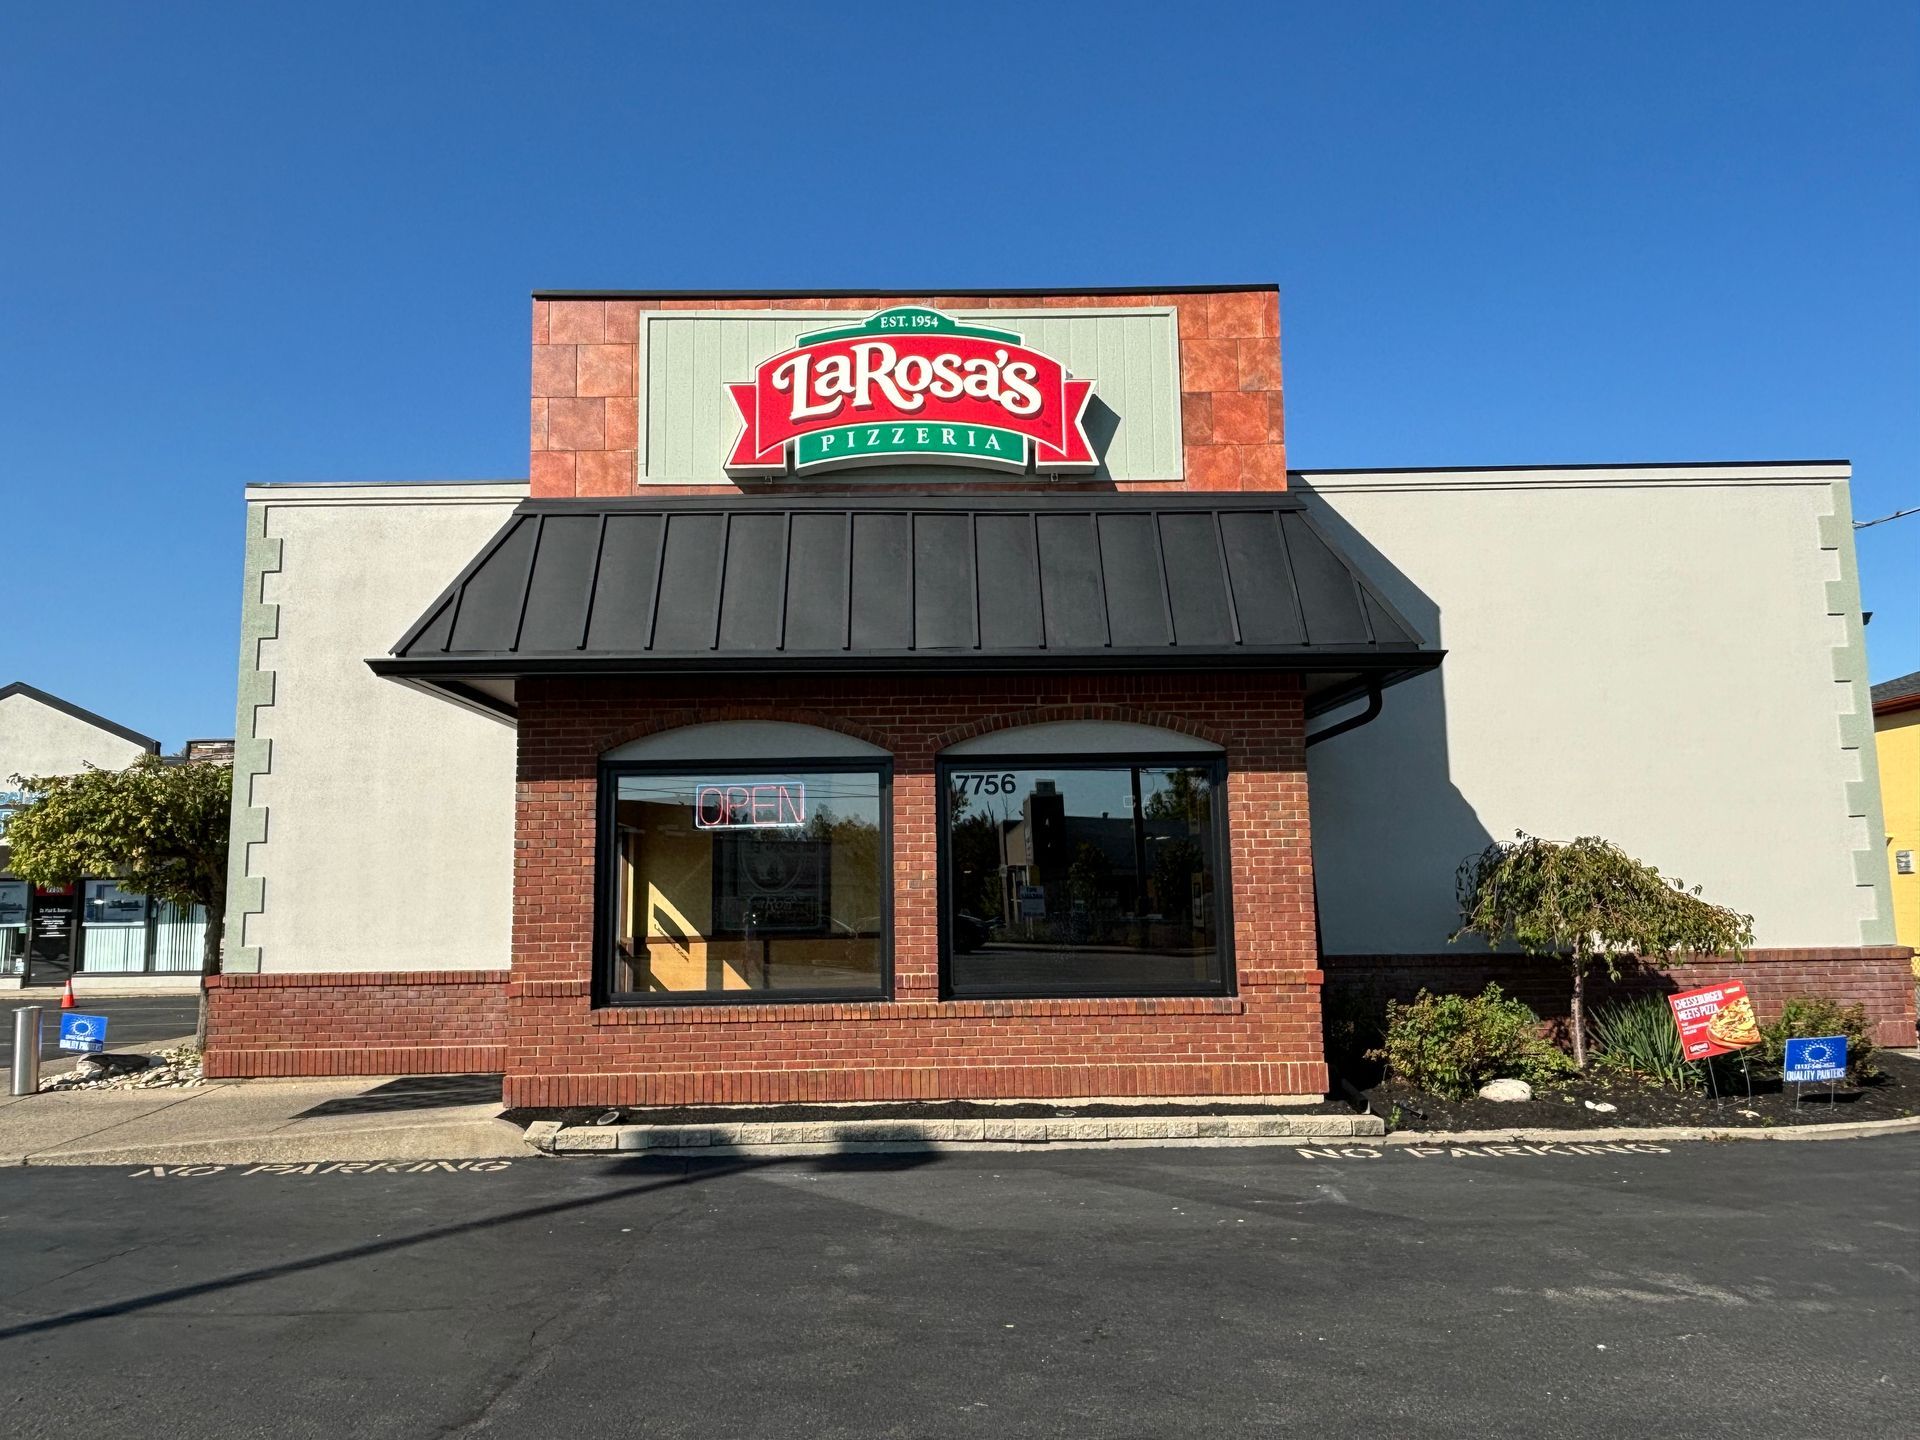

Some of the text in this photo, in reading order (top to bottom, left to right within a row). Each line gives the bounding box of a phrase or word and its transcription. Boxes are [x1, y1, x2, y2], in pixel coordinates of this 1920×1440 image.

[880, 315, 939, 329] EST. 1954
[771, 342, 1043, 422] LaRosa's
[820, 427, 1001, 453] PIZZERIA
[955, 773, 1017, 795] 7756
[699, 785, 805, 826] OPEN
[1677, 1003, 1719, 1022] MEETS PIZZA
[1786, 1068, 1845, 1081] QUALITY PAINTERS
[1296, 1143, 1671, 1160] NO PARKING
[128, 1160, 513, 1178] NO PARKING
